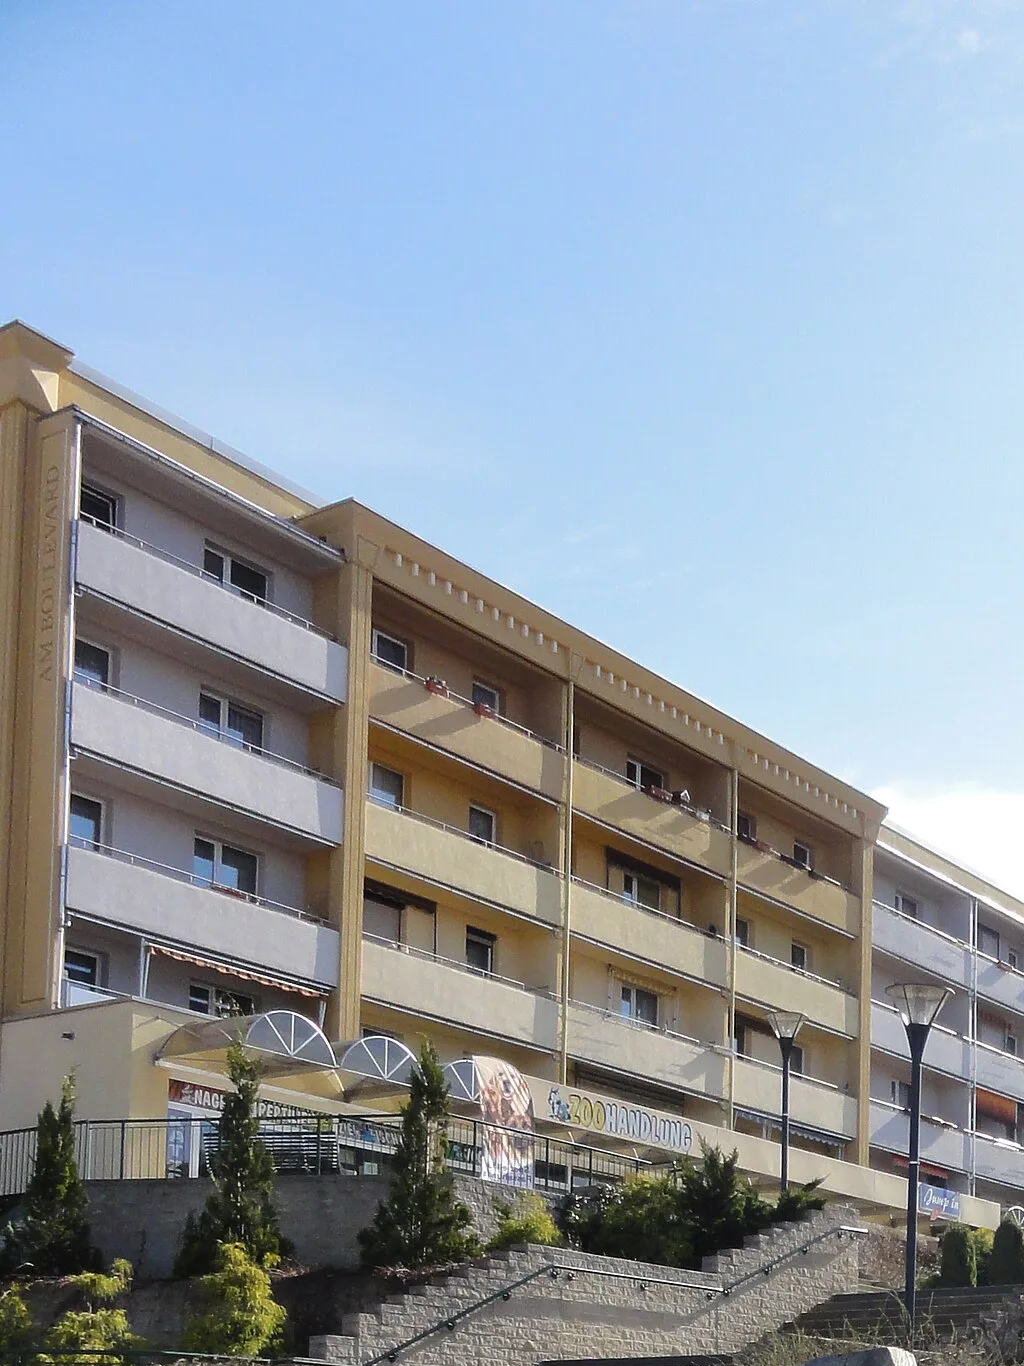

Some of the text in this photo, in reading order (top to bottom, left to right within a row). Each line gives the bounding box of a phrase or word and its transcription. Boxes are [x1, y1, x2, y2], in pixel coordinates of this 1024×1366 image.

[39, 464, 59, 682] AM BOULEVARD
[568, 1094, 692, 1150] ZOOHANDLUNG
